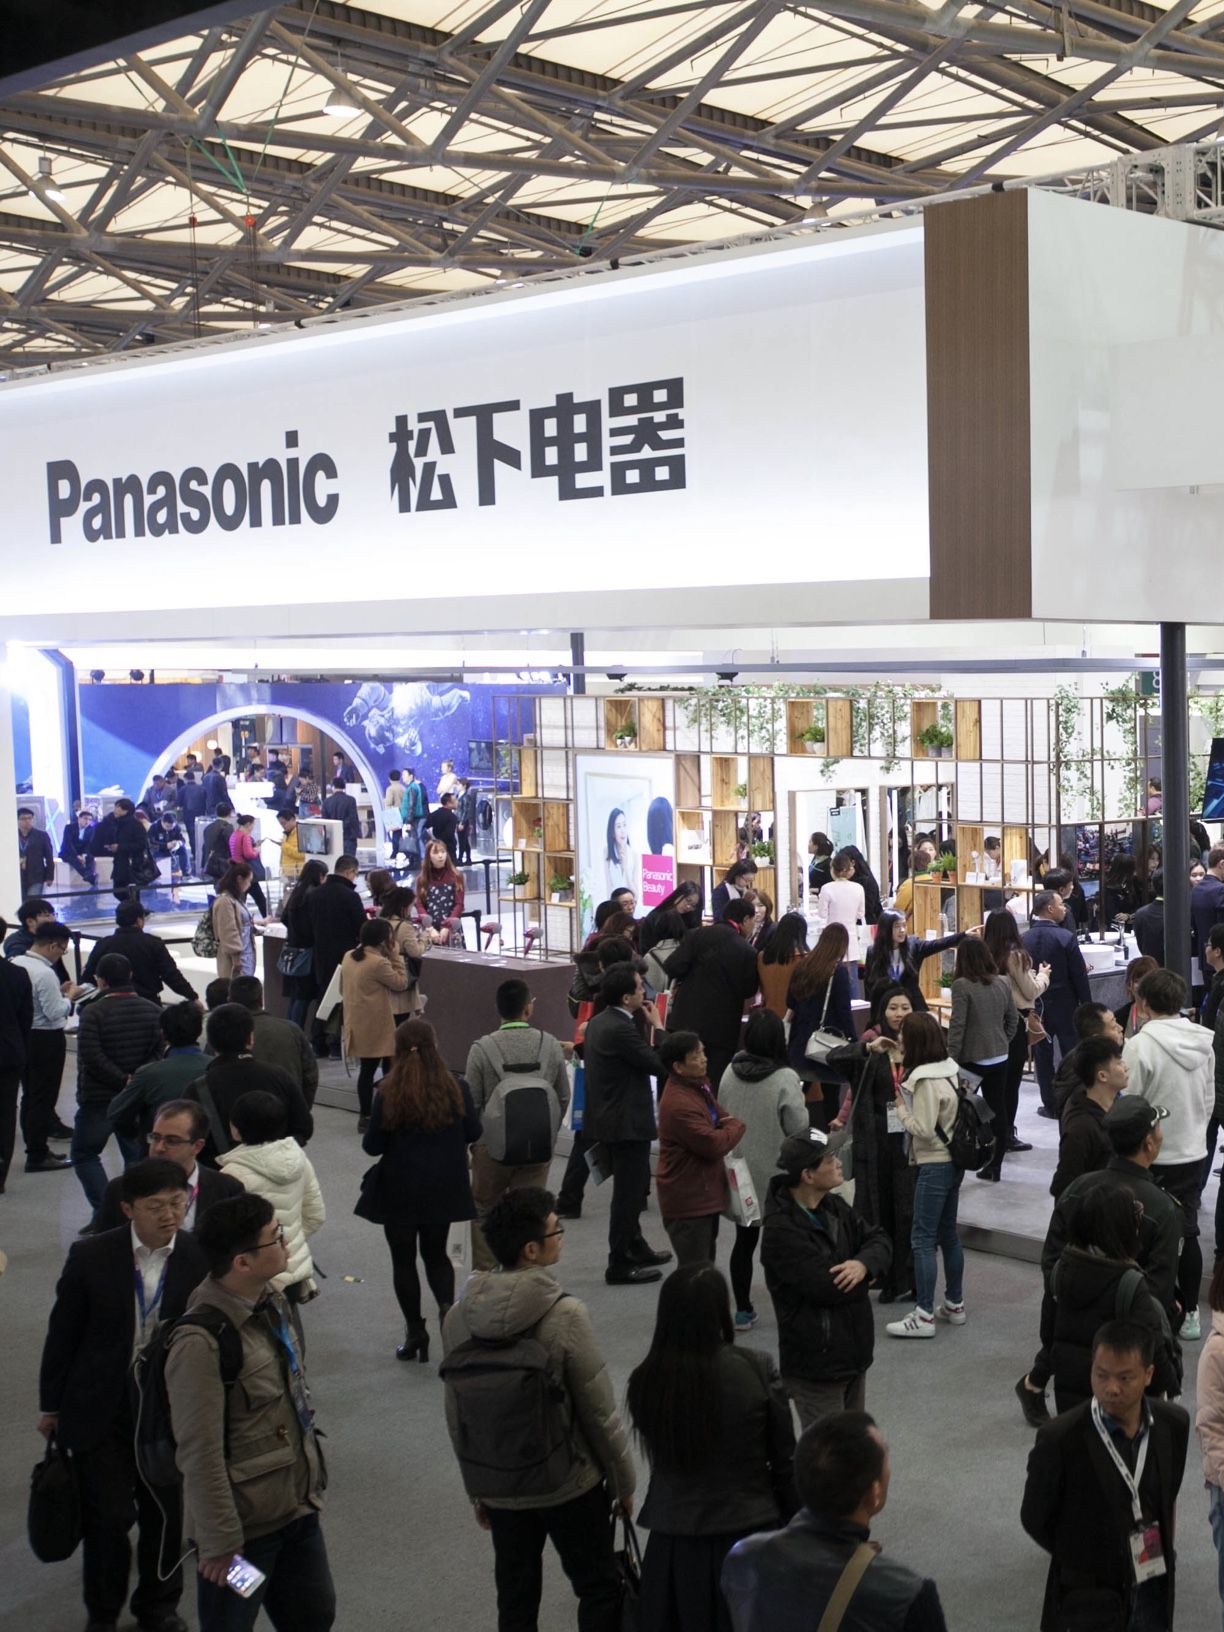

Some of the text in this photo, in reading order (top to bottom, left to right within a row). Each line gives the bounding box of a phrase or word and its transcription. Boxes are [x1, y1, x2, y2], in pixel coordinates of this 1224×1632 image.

[46, 430, 340, 544] Panasonic
[389, 377, 687, 513] 松下电器
